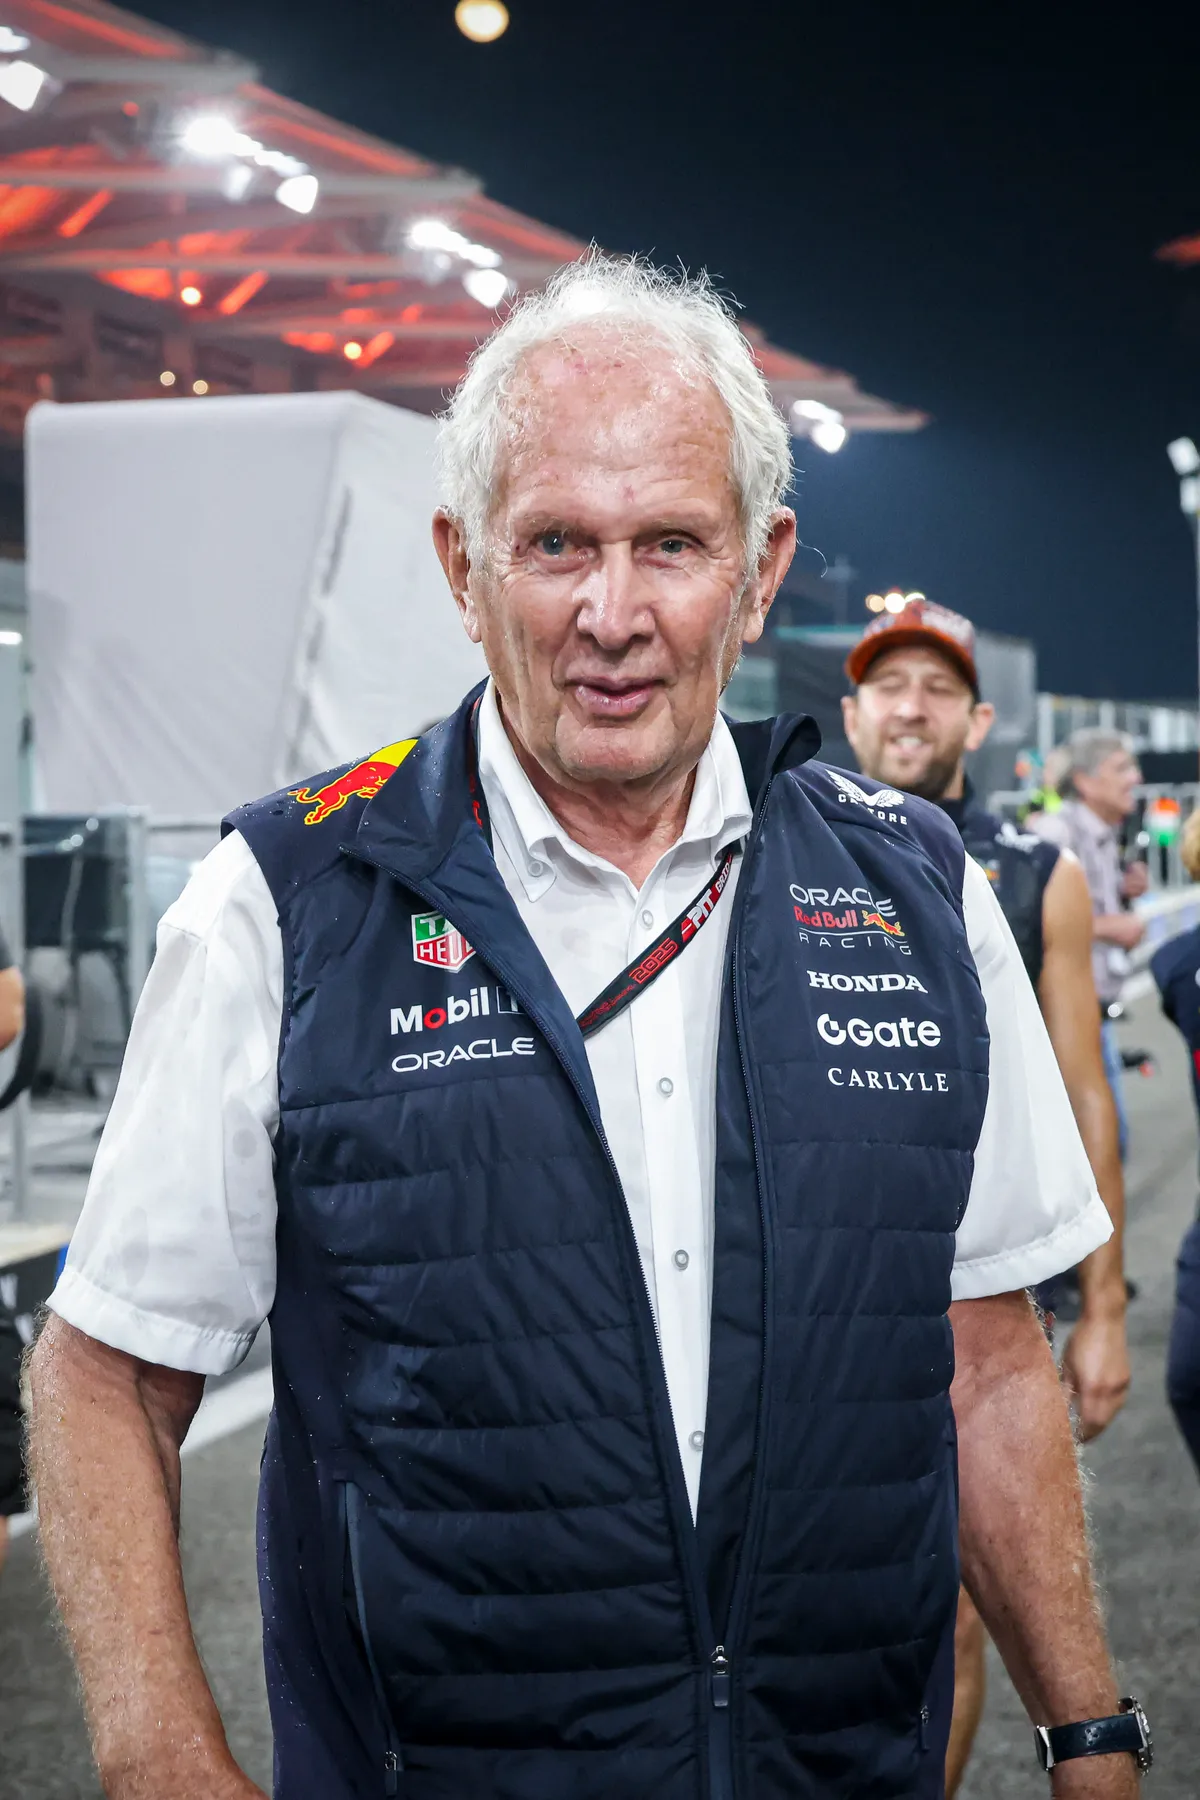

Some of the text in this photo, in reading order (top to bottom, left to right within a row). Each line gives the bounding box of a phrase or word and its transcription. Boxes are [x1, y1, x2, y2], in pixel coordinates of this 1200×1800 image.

[686, 889, 715, 930] PIT
[789, 883, 897, 917] ORACLE
[629, 937, 679, 984] 2025
[798, 932, 912, 955] RACING
[807, 970, 928, 994] HONDA
[390, 986, 490, 1035] Mobil
[391, 1037, 536, 1073] ORACLE
[827, 1067, 949, 1093] CARLYLE
